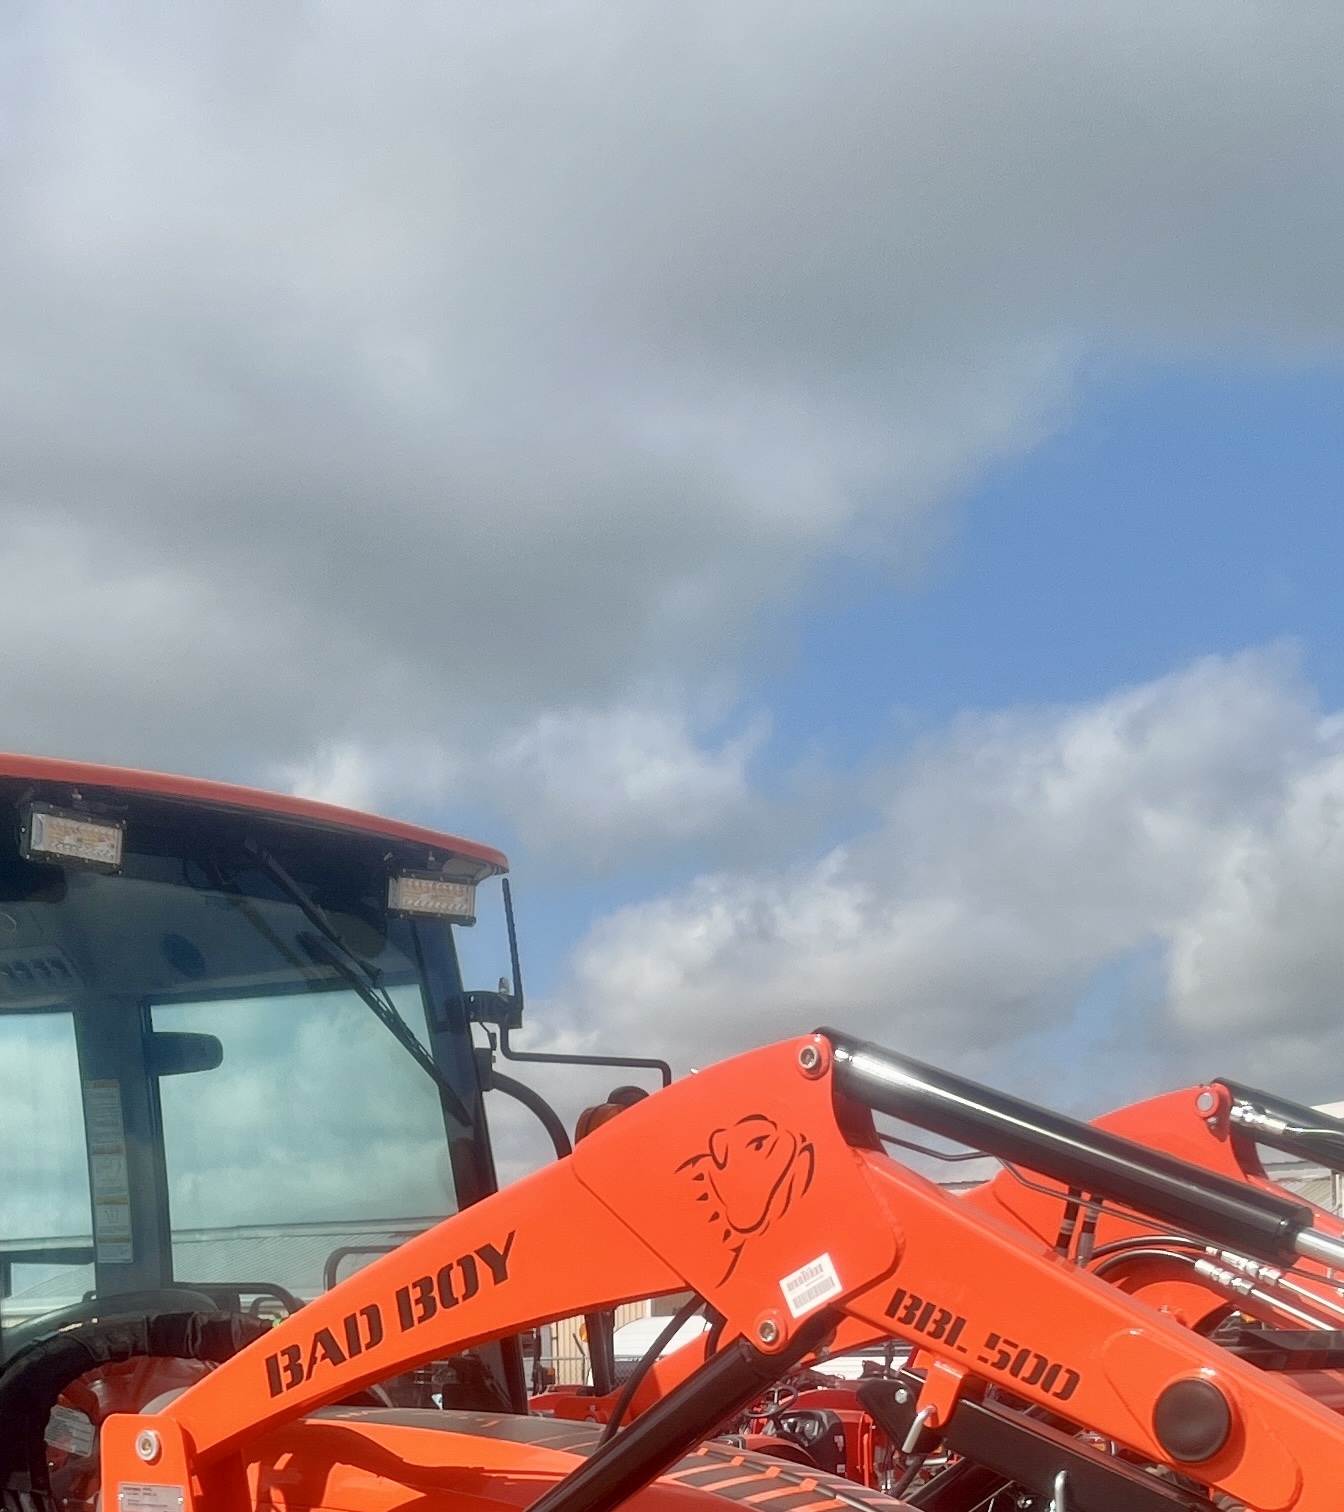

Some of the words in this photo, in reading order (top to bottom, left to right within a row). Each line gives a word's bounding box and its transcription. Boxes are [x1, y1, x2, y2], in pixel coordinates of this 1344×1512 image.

[265, 1302, 384, 1399] BAD
[395, 1230, 516, 1333] BOY
[884, 1287, 968, 1355] BBL
[977, 1331, 1081, 1402] 500
